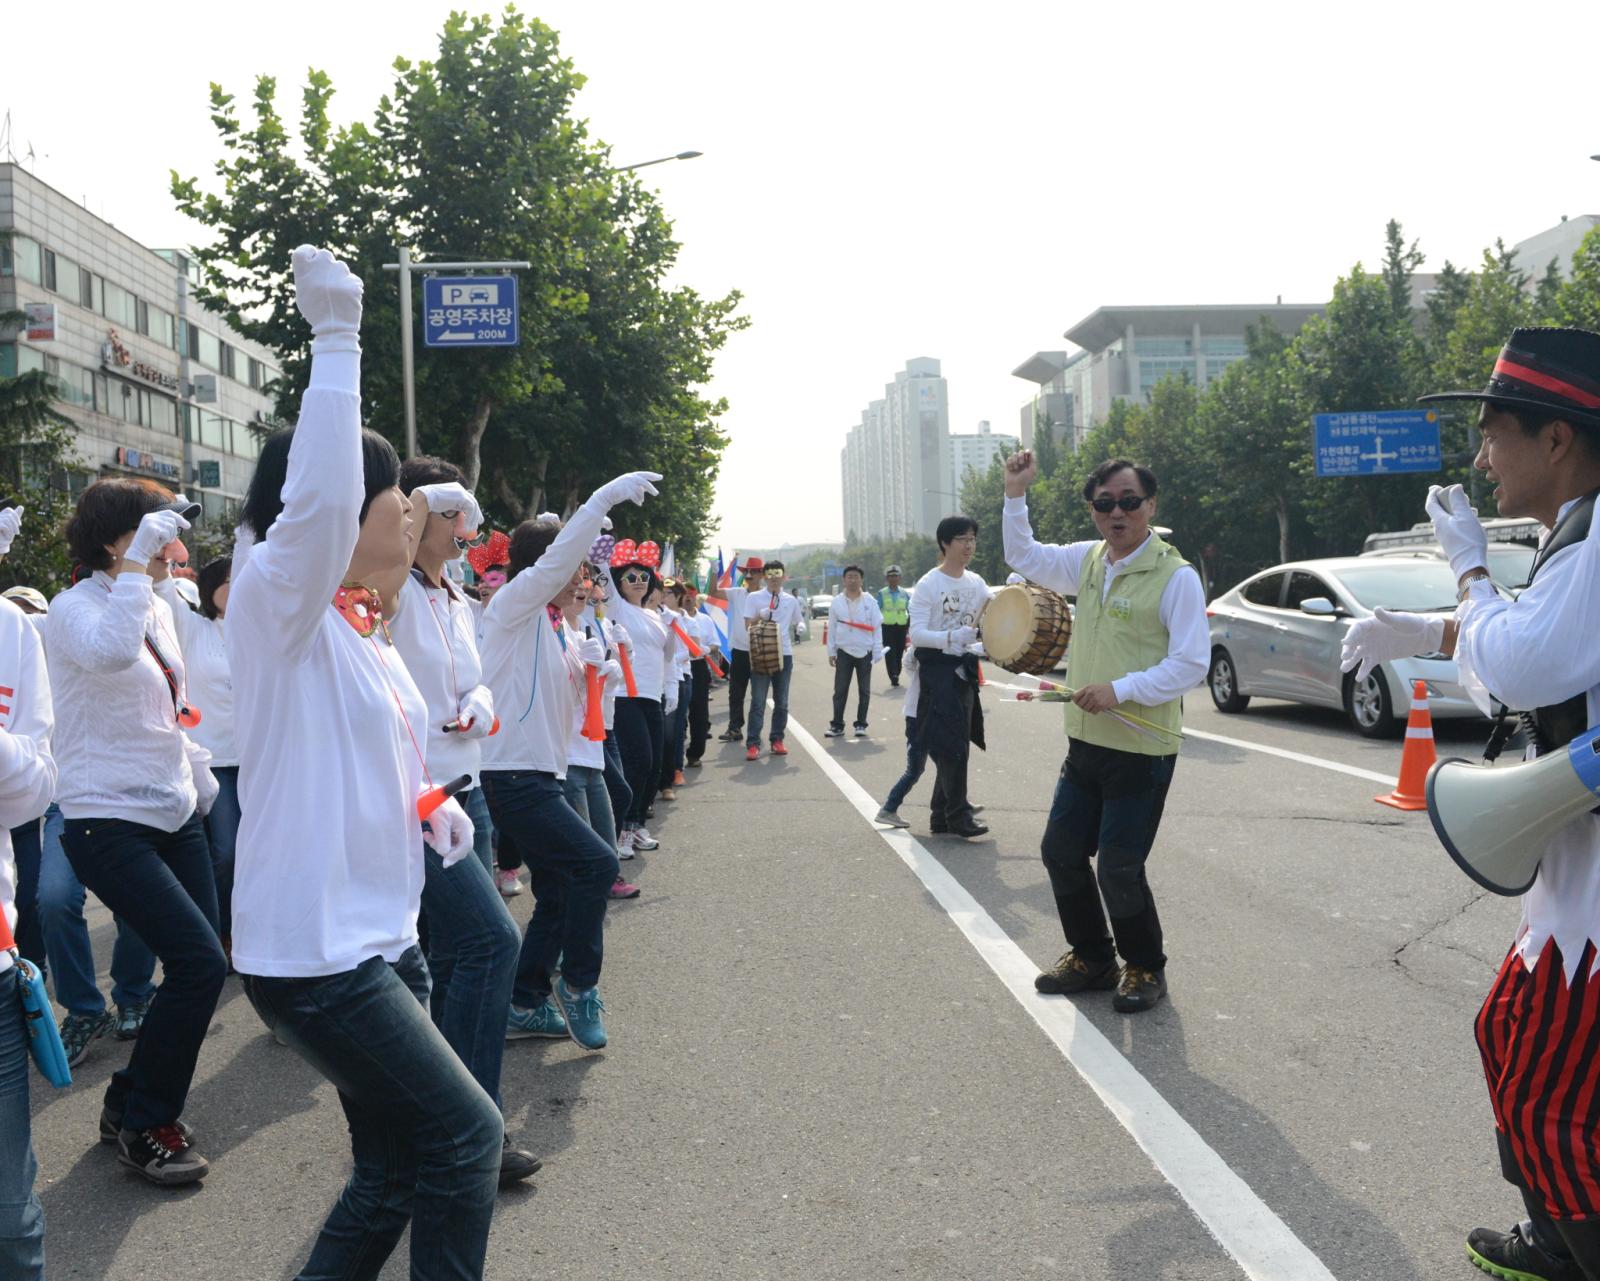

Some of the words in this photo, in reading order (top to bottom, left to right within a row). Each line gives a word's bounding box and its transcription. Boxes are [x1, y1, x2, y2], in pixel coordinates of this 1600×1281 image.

[451, 288, 462, 303] P
[428, 308, 512, 326] 공영주차장
[477, 330, 506, 339] 200M
